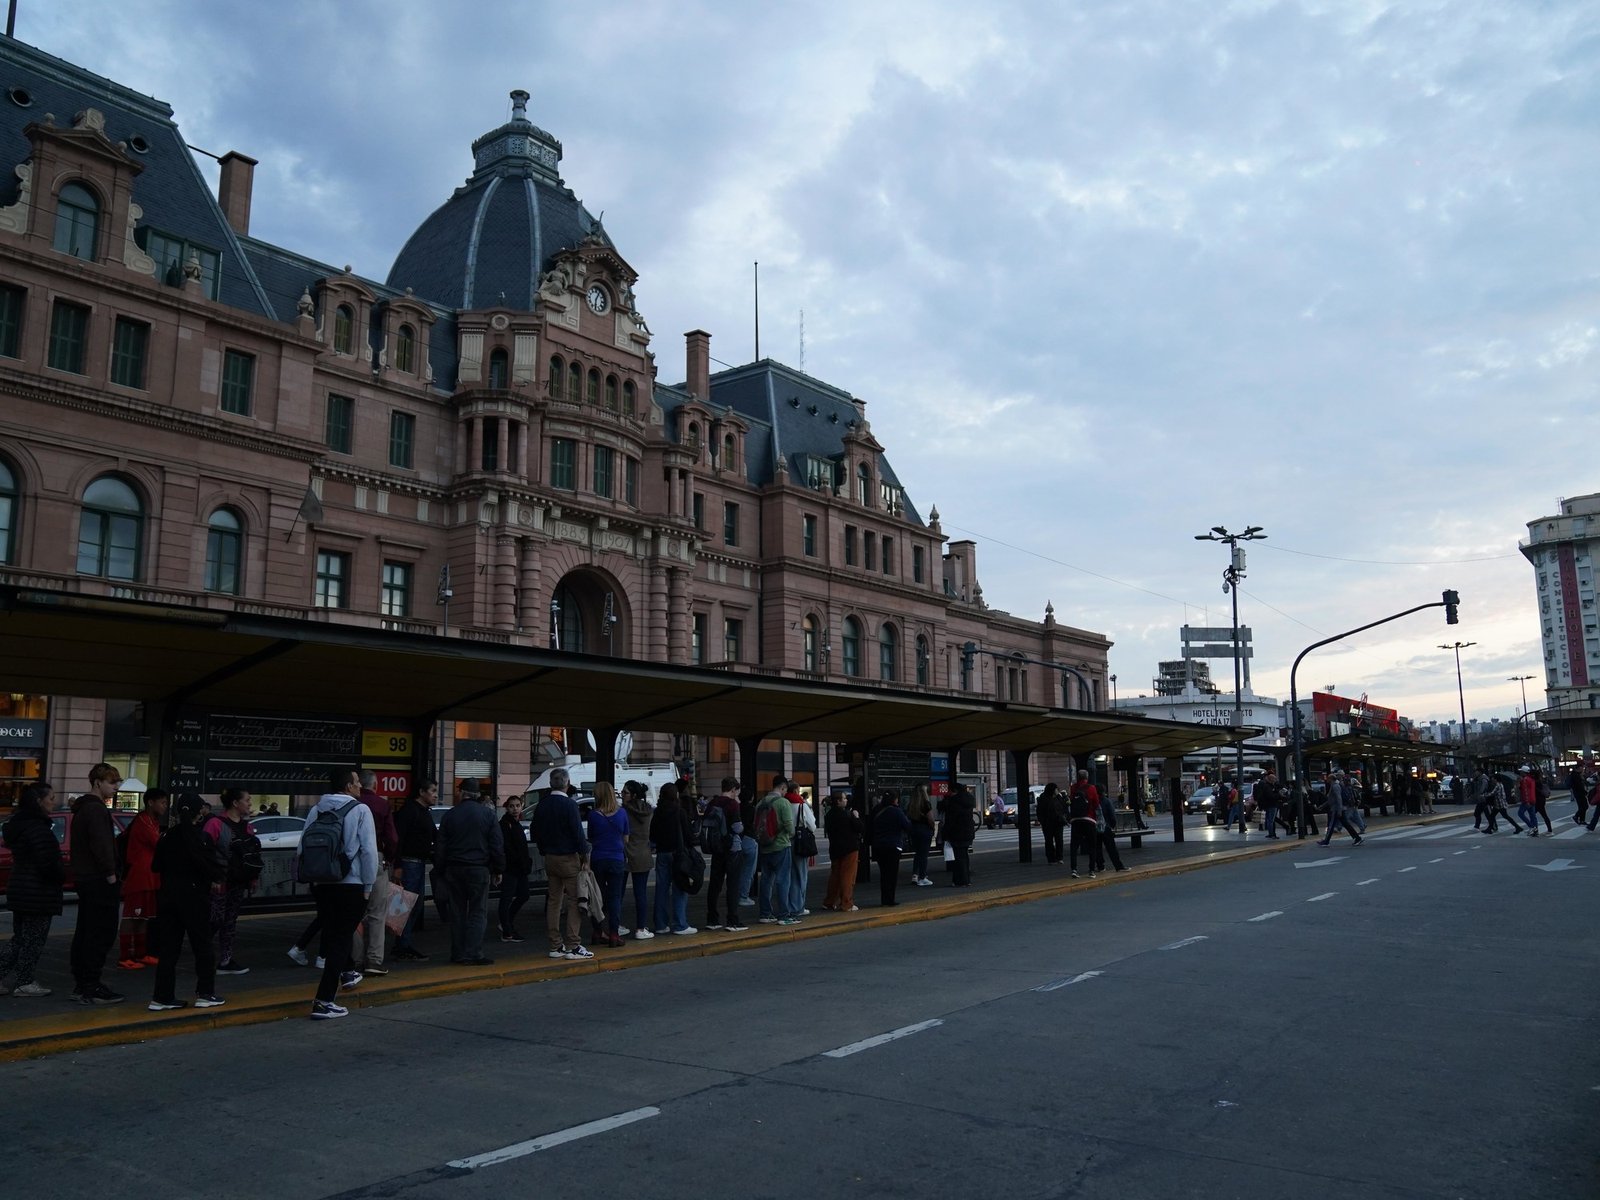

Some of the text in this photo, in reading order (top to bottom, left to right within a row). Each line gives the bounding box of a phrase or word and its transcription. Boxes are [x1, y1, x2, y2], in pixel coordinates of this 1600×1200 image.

[556, 522, 586, 541] 1885
[602, 532, 631, 549] 1907
[1193, 709, 1215, 717] HOTEL
[389, 737, 408, 752] 98
[941, 759, 949, 769] 51
[381, 776, 407, 792] 100
